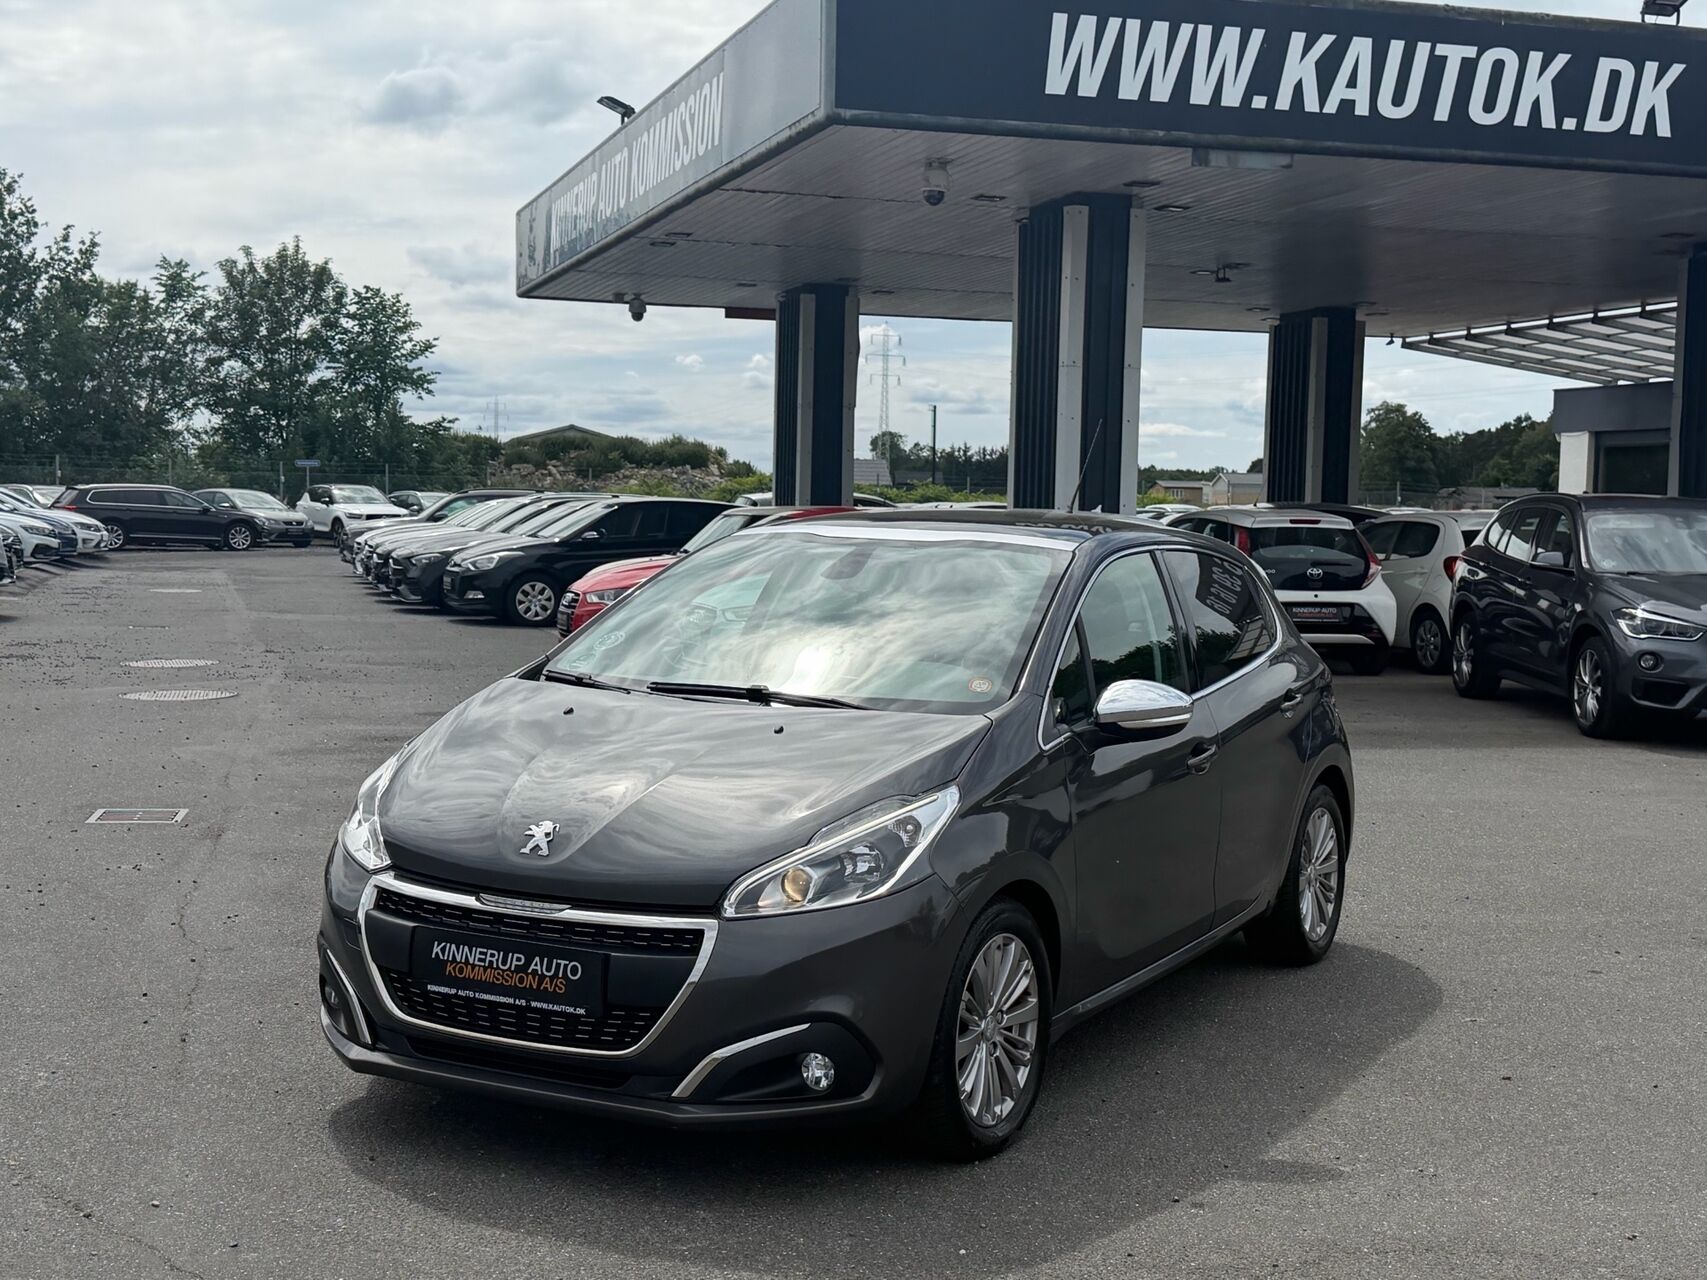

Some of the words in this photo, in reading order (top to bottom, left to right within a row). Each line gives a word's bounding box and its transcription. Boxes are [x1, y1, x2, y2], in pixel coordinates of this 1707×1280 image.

[1045, 12, 1687, 138] WWW.KAUTOK.DK
[550, 171, 598, 251] KINNERUP
[597, 147, 628, 222] AUTO
[629, 72, 724, 202] KOMMISSION
[431, 940, 525, 971] KINNERUP
[528, 956, 582, 980] AUTO
[445, 962, 539, 990] KOMMISSION
[540, 977, 566, 993] A/S
[427, 984, 457, 995] KINNERUP
[457, 989, 475, 998] AUTO
[475, 992, 514, 1005] KOMMISSION
[515, 998, 526, 1006] A/S
[530, 1001, 586, 1015] WWW.KAUTOK.DK
